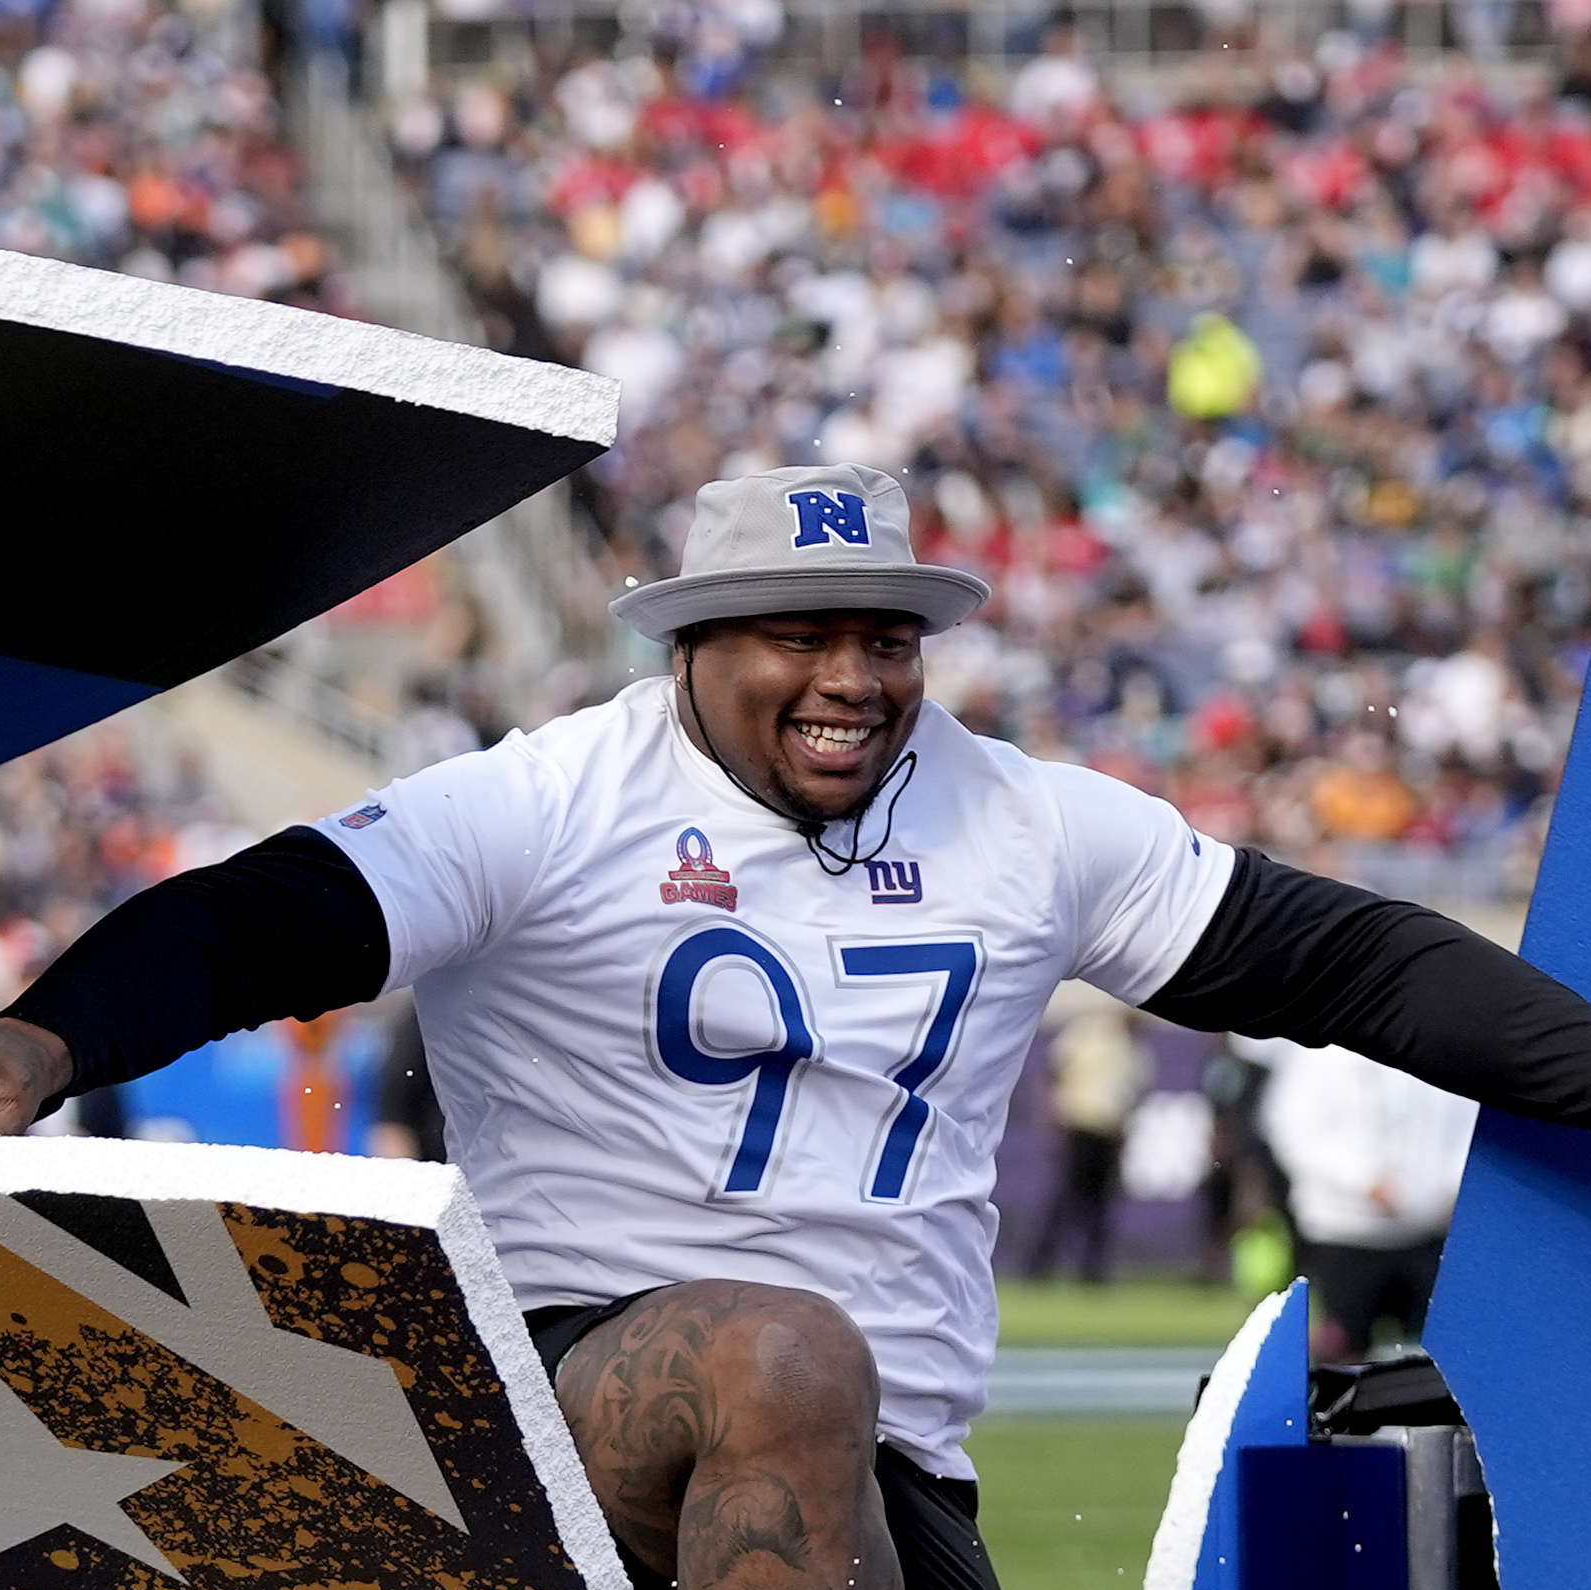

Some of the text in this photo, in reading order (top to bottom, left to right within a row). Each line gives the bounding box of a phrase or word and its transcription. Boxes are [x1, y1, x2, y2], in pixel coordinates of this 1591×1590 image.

[786, 489, 872, 551] N
[660, 881, 738, 913] GAMES
[646, 918, 985, 1202] 97
